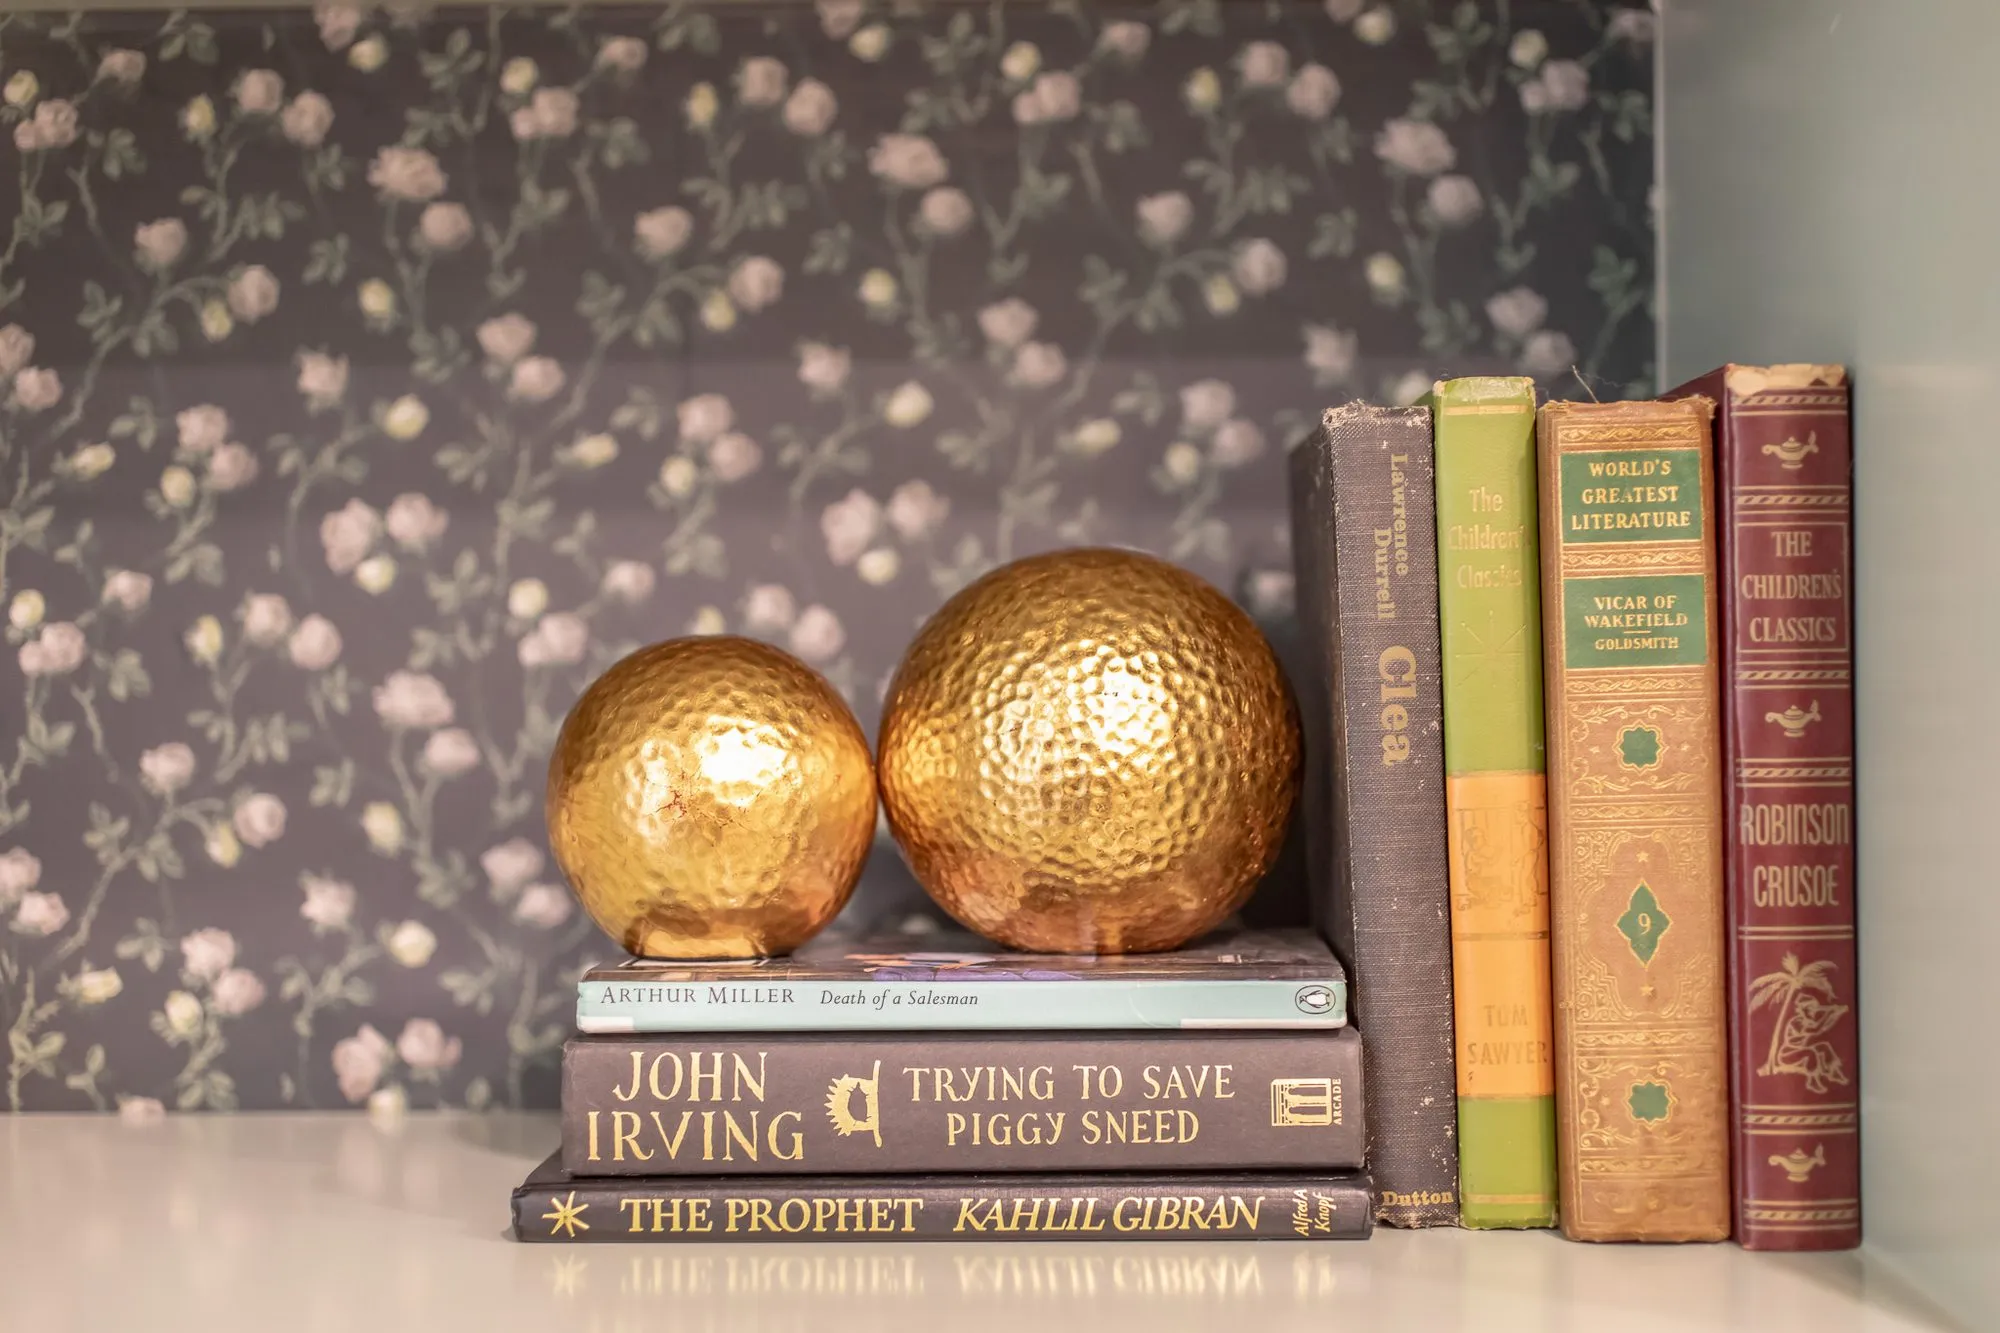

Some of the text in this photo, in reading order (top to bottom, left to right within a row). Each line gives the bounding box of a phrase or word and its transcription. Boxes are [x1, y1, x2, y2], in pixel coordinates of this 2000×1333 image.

[1588, 458, 1672, 478] WORLD'S
[1468, 486, 1503, 513] The
[1581, 485, 1680, 505] GREATEST
[1391, 453, 1409, 577] Lawrence
[1571, 511, 1692, 531] LITERATURE
[1448, 523, 1531, 551] Children'
[1770, 530, 1813, 557] THE
[1374, 526, 1396, 620] Durrell
[1741, 568, 1842, 601] CHILDREN'S
[1593, 595, 1678, 611] VICAR OF
[1584, 612, 1689, 629] WAKEFIELD
[1749, 616, 1837, 642] CLASSICS
[1594, 636, 1680, 651] GOLDSMITH
[1378, 645, 1418, 767] Clea
[1739, 803, 1849, 847] ROBINSON
[1753, 864, 1840, 908] CRUSOE
[1637, 912, 1652, 937] 9
[600, 985, 979, 1011] ARTHUR MILLER Death of a Salesman
[1467, 1041, 1548, 1066] SAWYER
[612, 1051, 768, 1103] JOHN
[902, 1064, 1236, 1102] TRYING TO SAVE
[1332, 1078, 1342, 1126] ARCADE
[587, 1110, 804, 1162] IRVING
[947, 1109, 1200, 1147] PIGGY SNEED
[1312, 1191, 1337, 1233] Knopf
[1381, 1191, 1454, 1207] Dutton
[620, 1196, 1265, 1233] THE PROPHET KAHLIL GIBRAN
